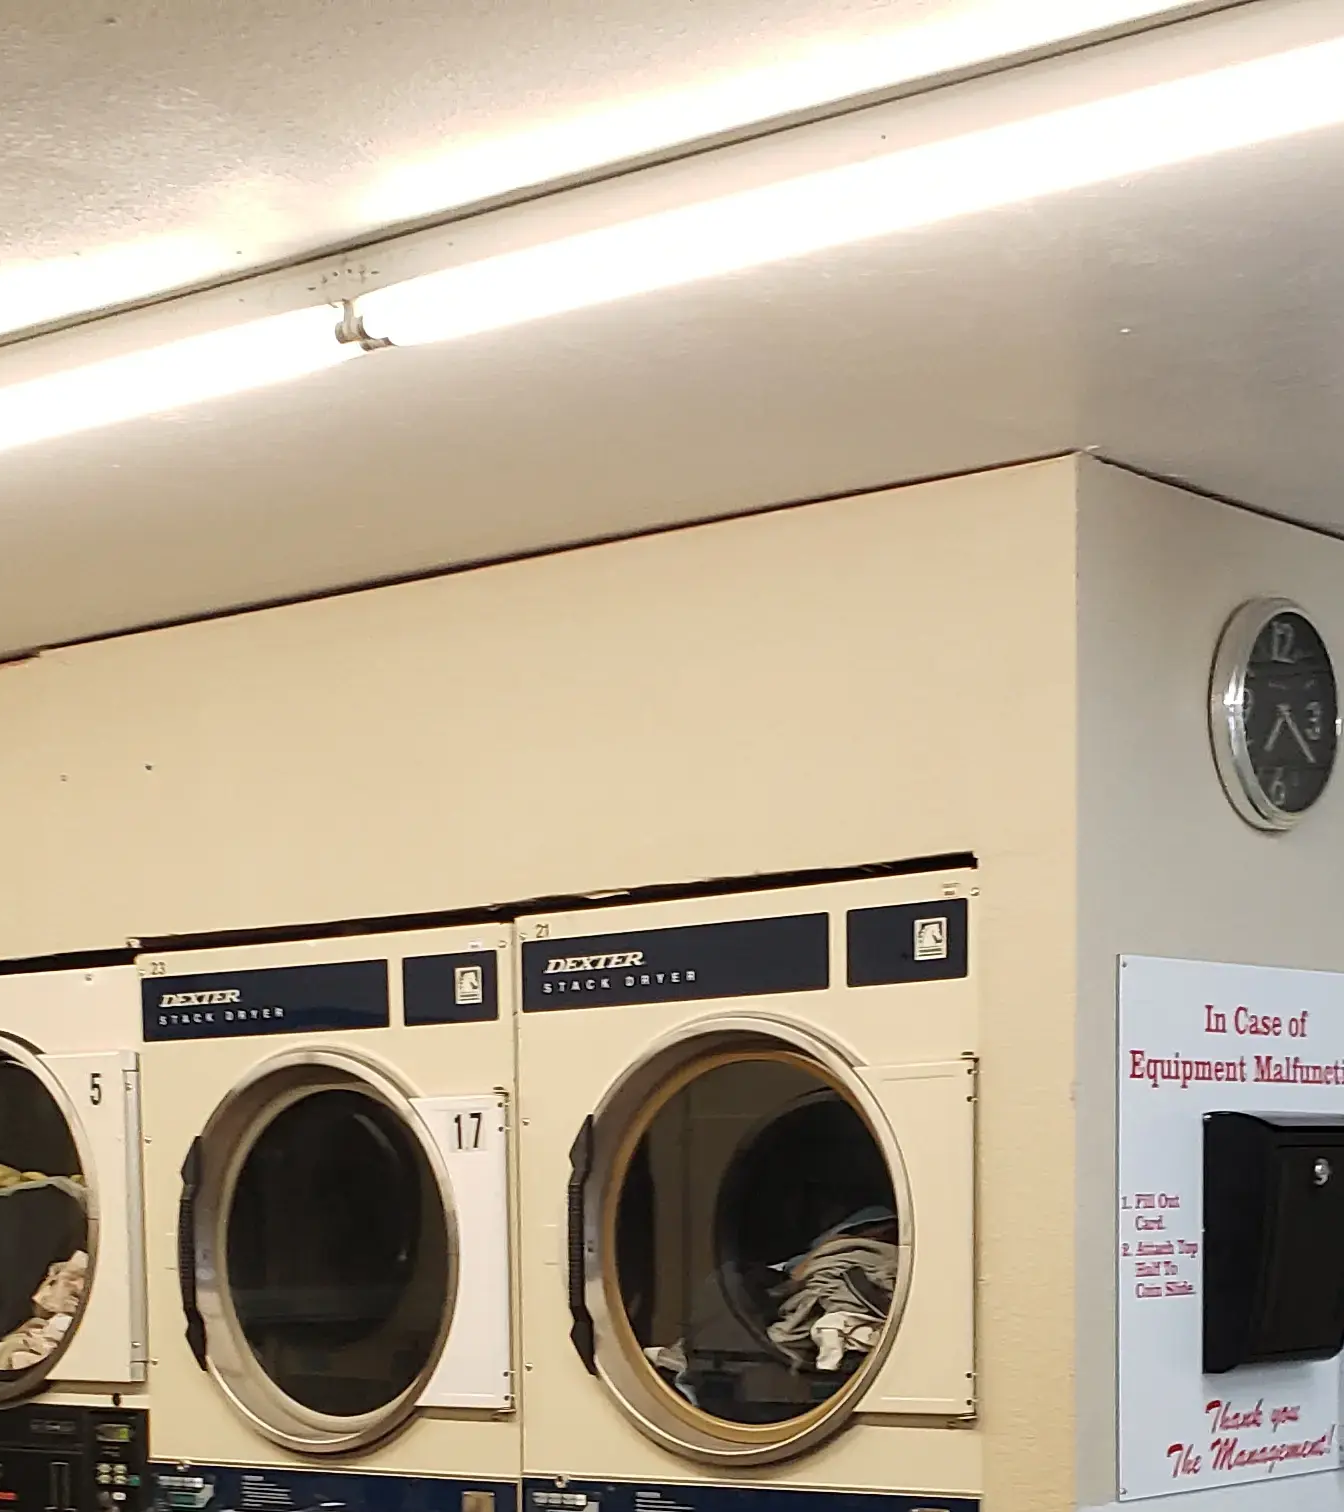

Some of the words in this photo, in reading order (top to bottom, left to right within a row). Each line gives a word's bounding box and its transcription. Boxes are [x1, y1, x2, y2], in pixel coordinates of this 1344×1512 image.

[543, 951, 646, 974] DEXTER
[159, 989, 242, 1008] DEXTER
[543, 978, 612, 994] STACK
[625, 970, 697, 988] DRYER
[159, 1012, 215, 1026] STACK
[224, 1007, 285, 1022] DRYER
[1204, 1004, 1228, 1034] In
[1234, 1006, 1282, 1037] Case
[1289, 1010, 1310, 1038] of
[1129, 1050, 1247, 1089] Equipment
[89, 1072, 104, 1107] 5
[453, 1112, 483, 1150] 17
[1205, 1398, 1265, 1434] Thank
[1270, 1405, 1301, 1433] you
[1167, 1443, 1202, 1478] The
